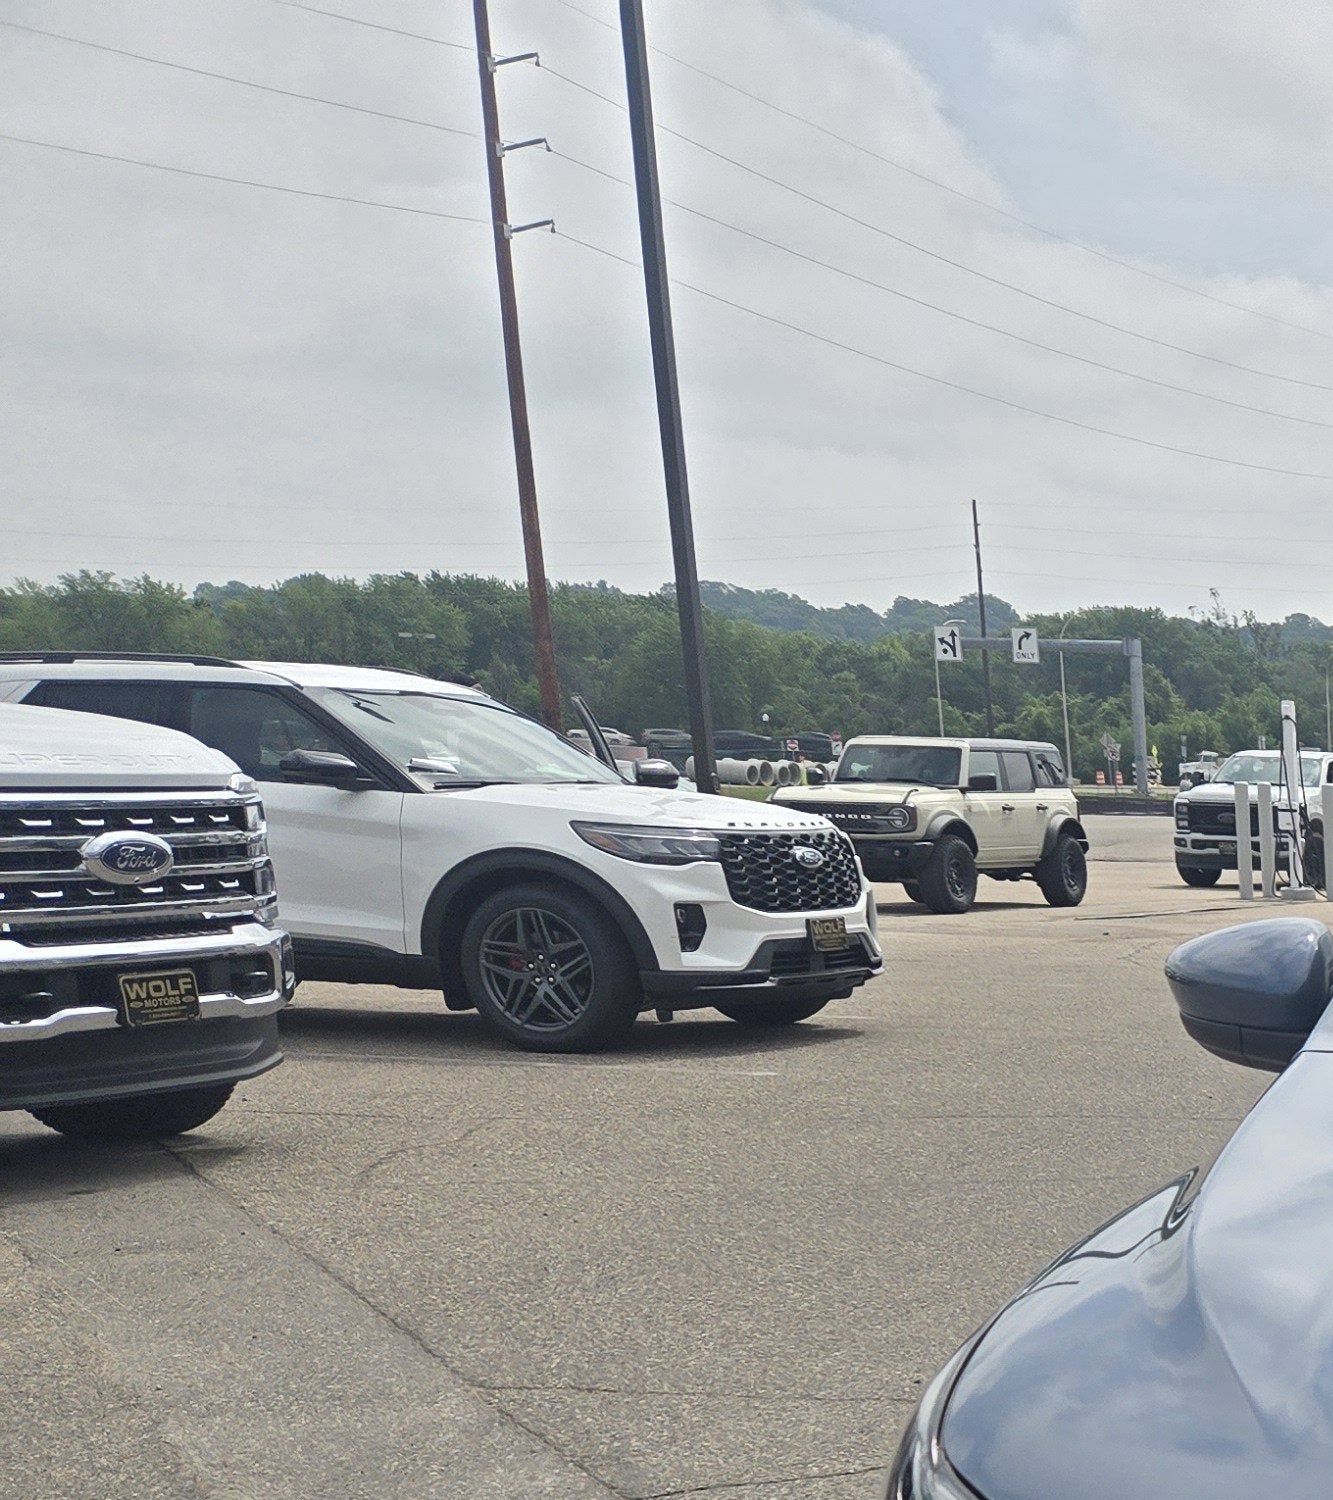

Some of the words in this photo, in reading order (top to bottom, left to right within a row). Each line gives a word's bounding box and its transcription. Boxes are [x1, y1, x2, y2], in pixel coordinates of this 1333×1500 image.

[1016, 651, 1036, 660] ONLY
[116, 846, 157, 869] Ford
[811, 920, 845, 935] WOLF
[125, 977, 192, 1000] WOLF
[144, 996, 181, 1008] MOTORS
